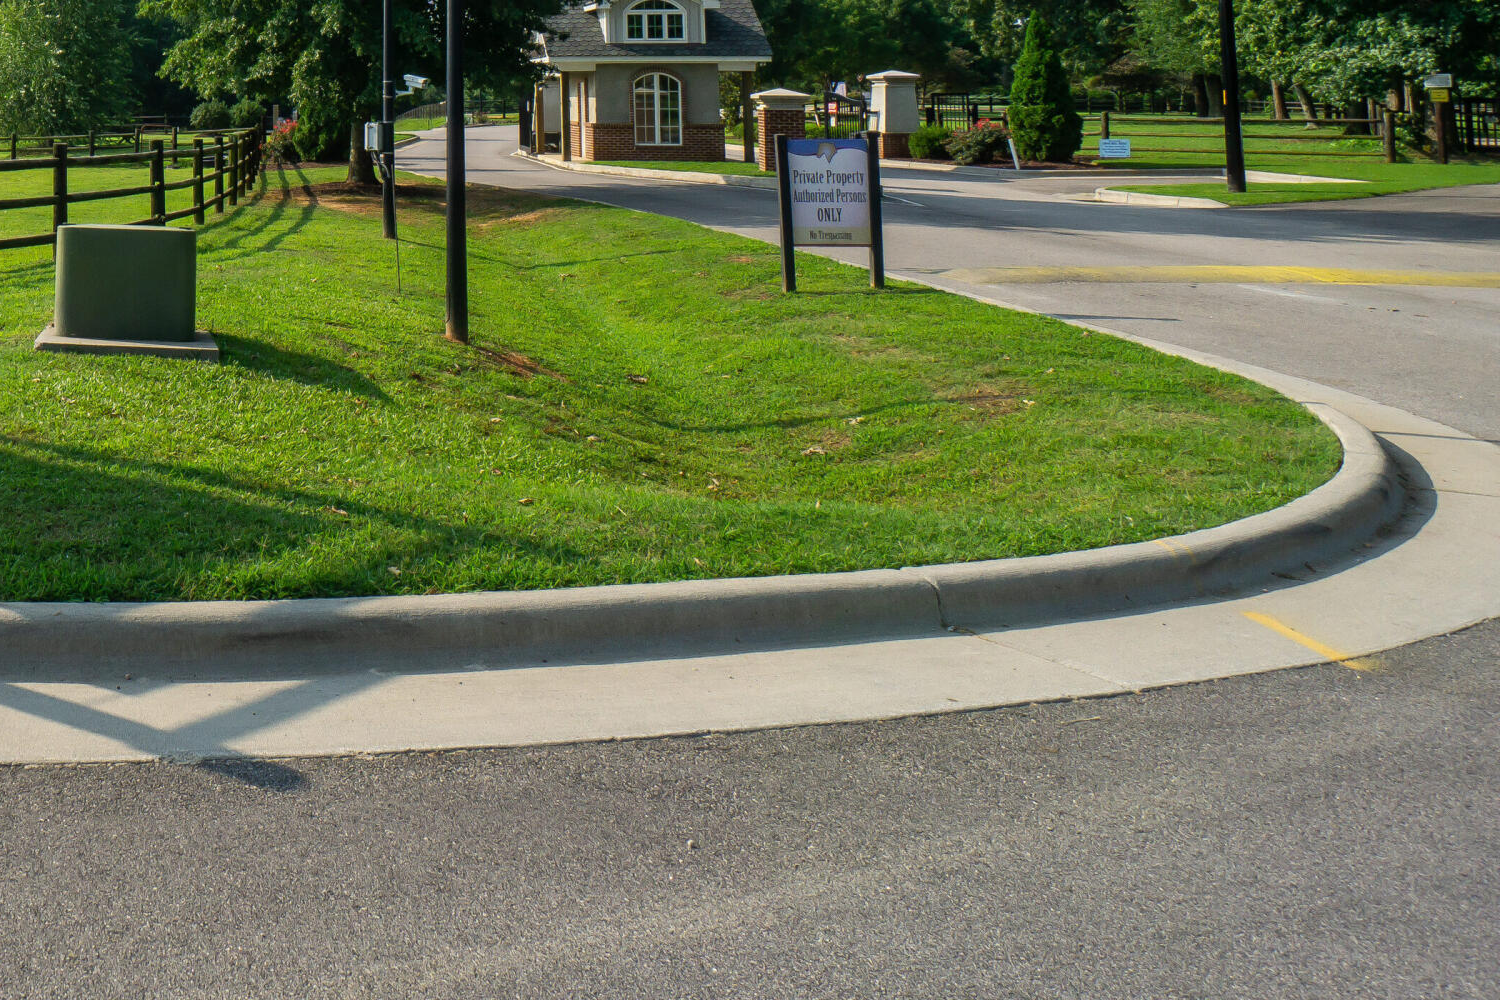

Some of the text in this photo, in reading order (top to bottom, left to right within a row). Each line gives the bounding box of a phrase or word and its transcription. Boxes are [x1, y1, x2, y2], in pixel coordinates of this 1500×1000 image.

[793, 169, 864, 186] Private Property
[793, 188, 867, 203] Authorized Persons
[817, 207, 842, 222] ONLY
[809, 230, 817, 240] No
